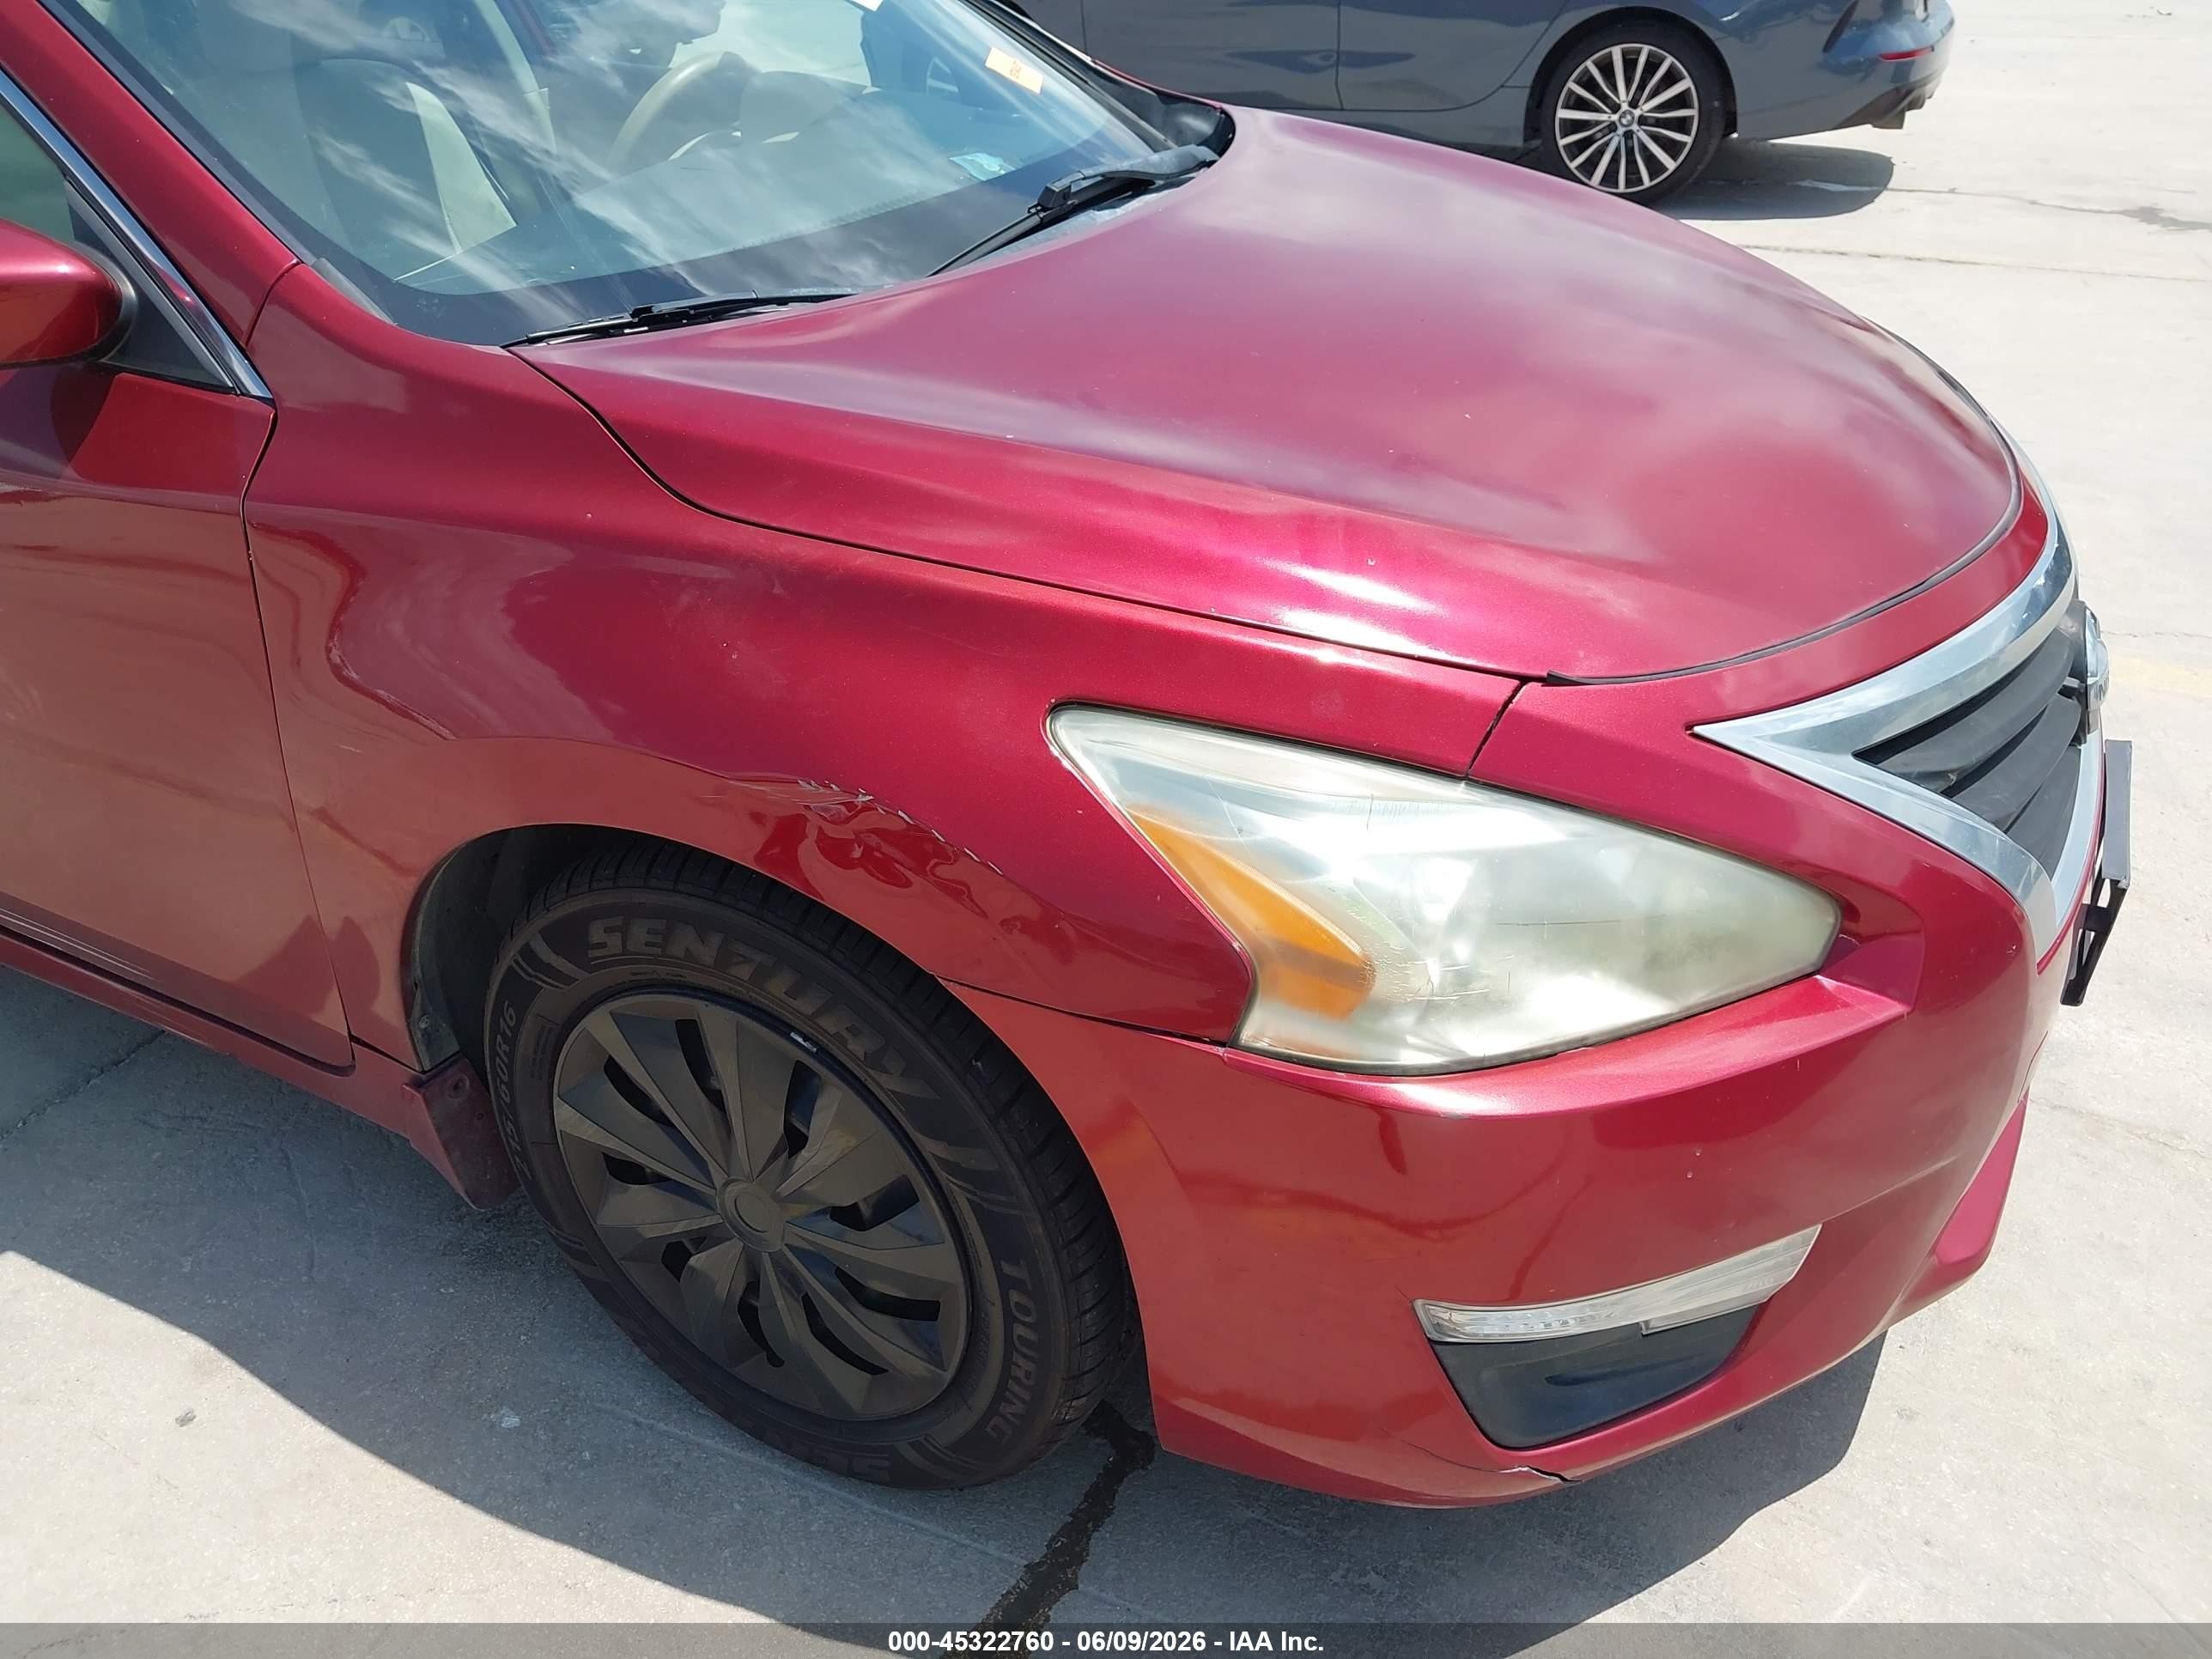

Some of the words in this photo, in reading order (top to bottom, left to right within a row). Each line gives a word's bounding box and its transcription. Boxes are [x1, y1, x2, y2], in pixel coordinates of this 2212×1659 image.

[495, 1000, 532, 1180] 215/60R16
[588, 916, 942, 1099] SENTURY
[985, 1258, 1040, 1445] TOURING
